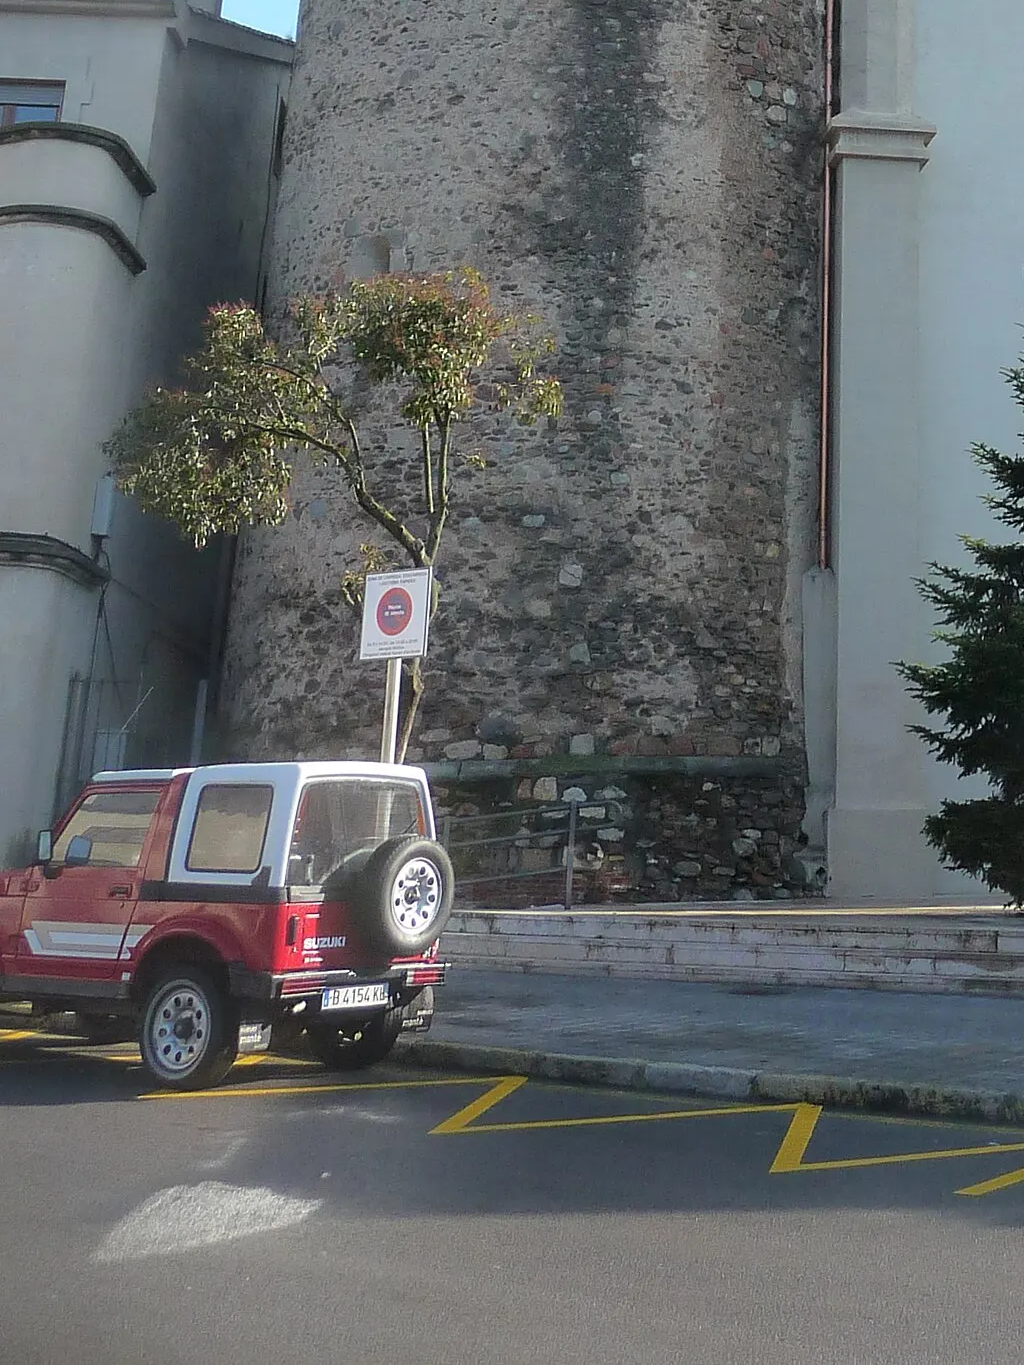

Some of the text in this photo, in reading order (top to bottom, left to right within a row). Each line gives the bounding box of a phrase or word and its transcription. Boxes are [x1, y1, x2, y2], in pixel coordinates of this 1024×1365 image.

[303, 937, 346, 949] SUZUKI
[332, 990, 340, 1005] B
[343, 987, 370, 1004] 4154
